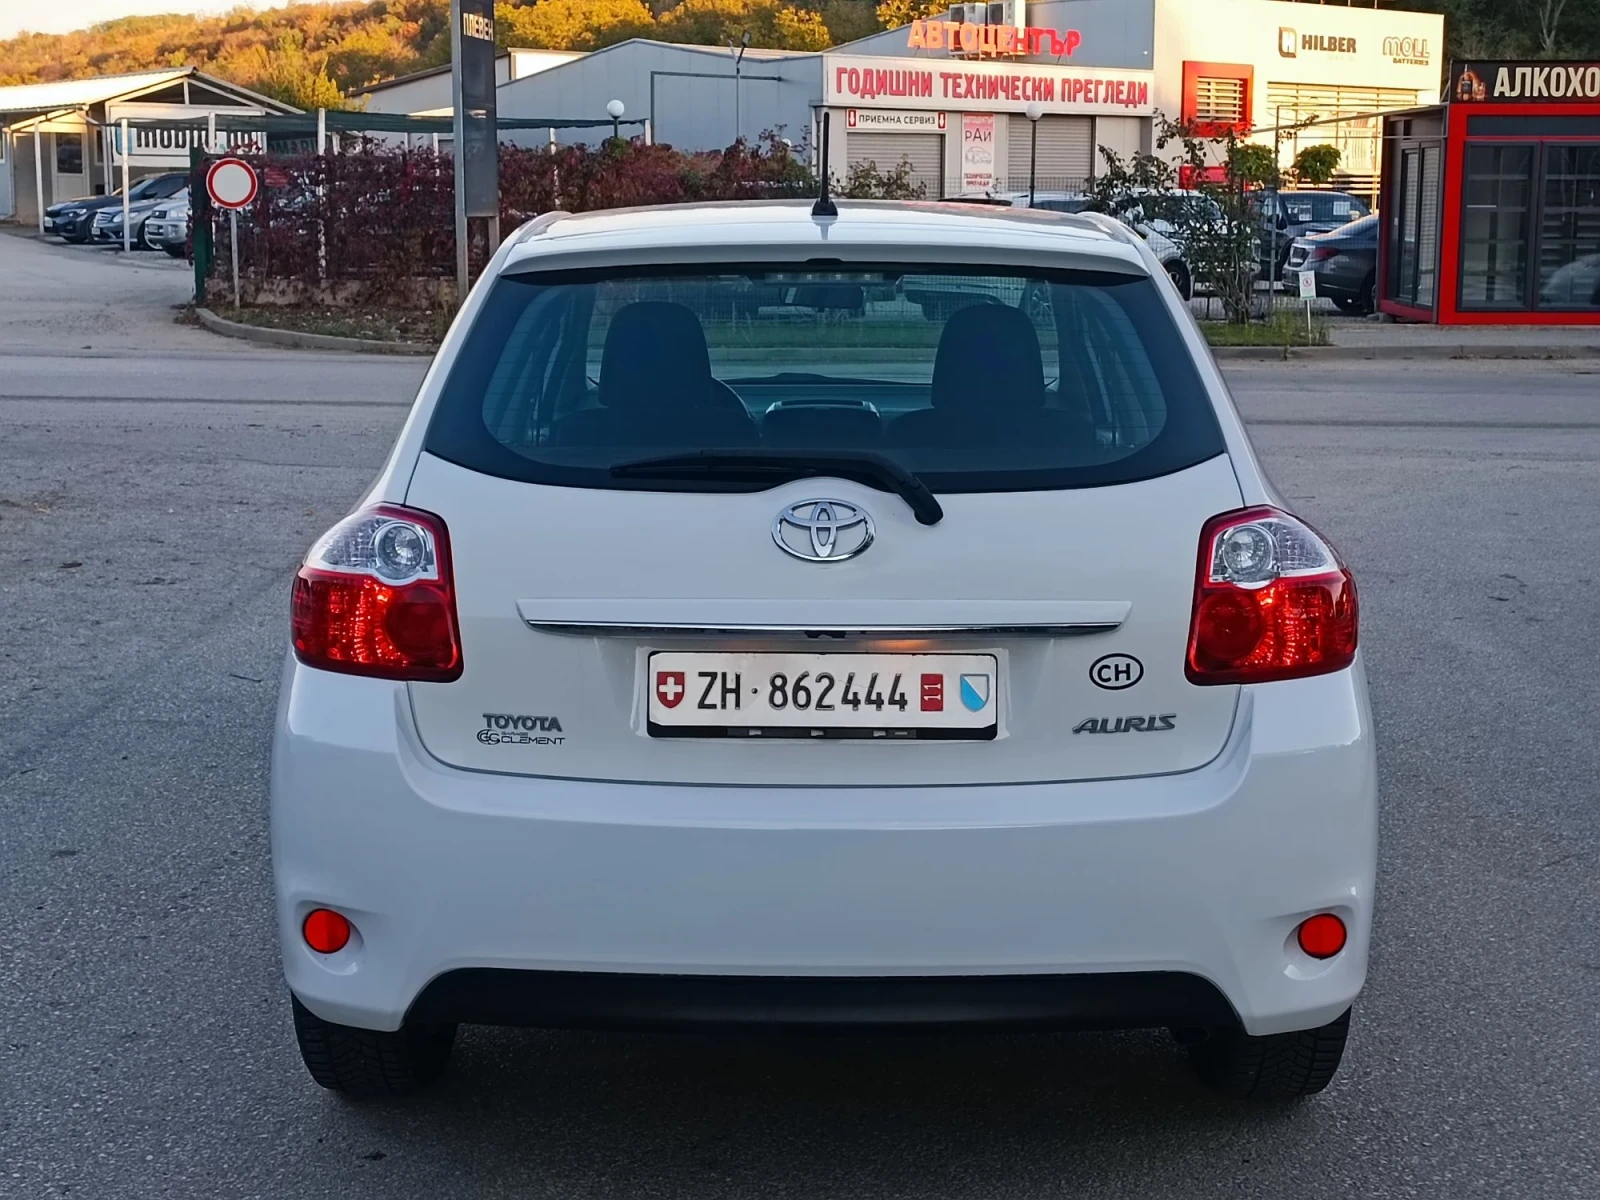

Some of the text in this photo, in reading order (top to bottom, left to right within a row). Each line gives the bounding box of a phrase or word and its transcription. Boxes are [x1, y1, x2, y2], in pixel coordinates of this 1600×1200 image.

[463, 12, 494, 41] ПЛЕВЕН
[907, 19, 1082, 58] АВТОЦЕНТЪР
[1301, 34, 1357, 54] HILBER
[1382, 36, 1430, 58] MOLL
[835, 66, 1148, 109] ГОДИШНИ ТЕХНИЧЕСКИ ПРЕГЛЕДИ
[1493, 66, 1600, 98] АЛКОХО
[858, 114, 936, 125] ПРИЕМНА СЕРВИЗ
[965, 127, 992, 142] РАЙ
[1097, 663, 1131, 683] CH
[697, 671, 742, 710] ZH
[768, 671, 908, 712] 862444
[923, 683, 942, 702] 11
[482, 713, 563, 733] TOYOTA
[1072, 713, 1178, 735] AURIS
[501, 736, 566, 746] CLEMENT
